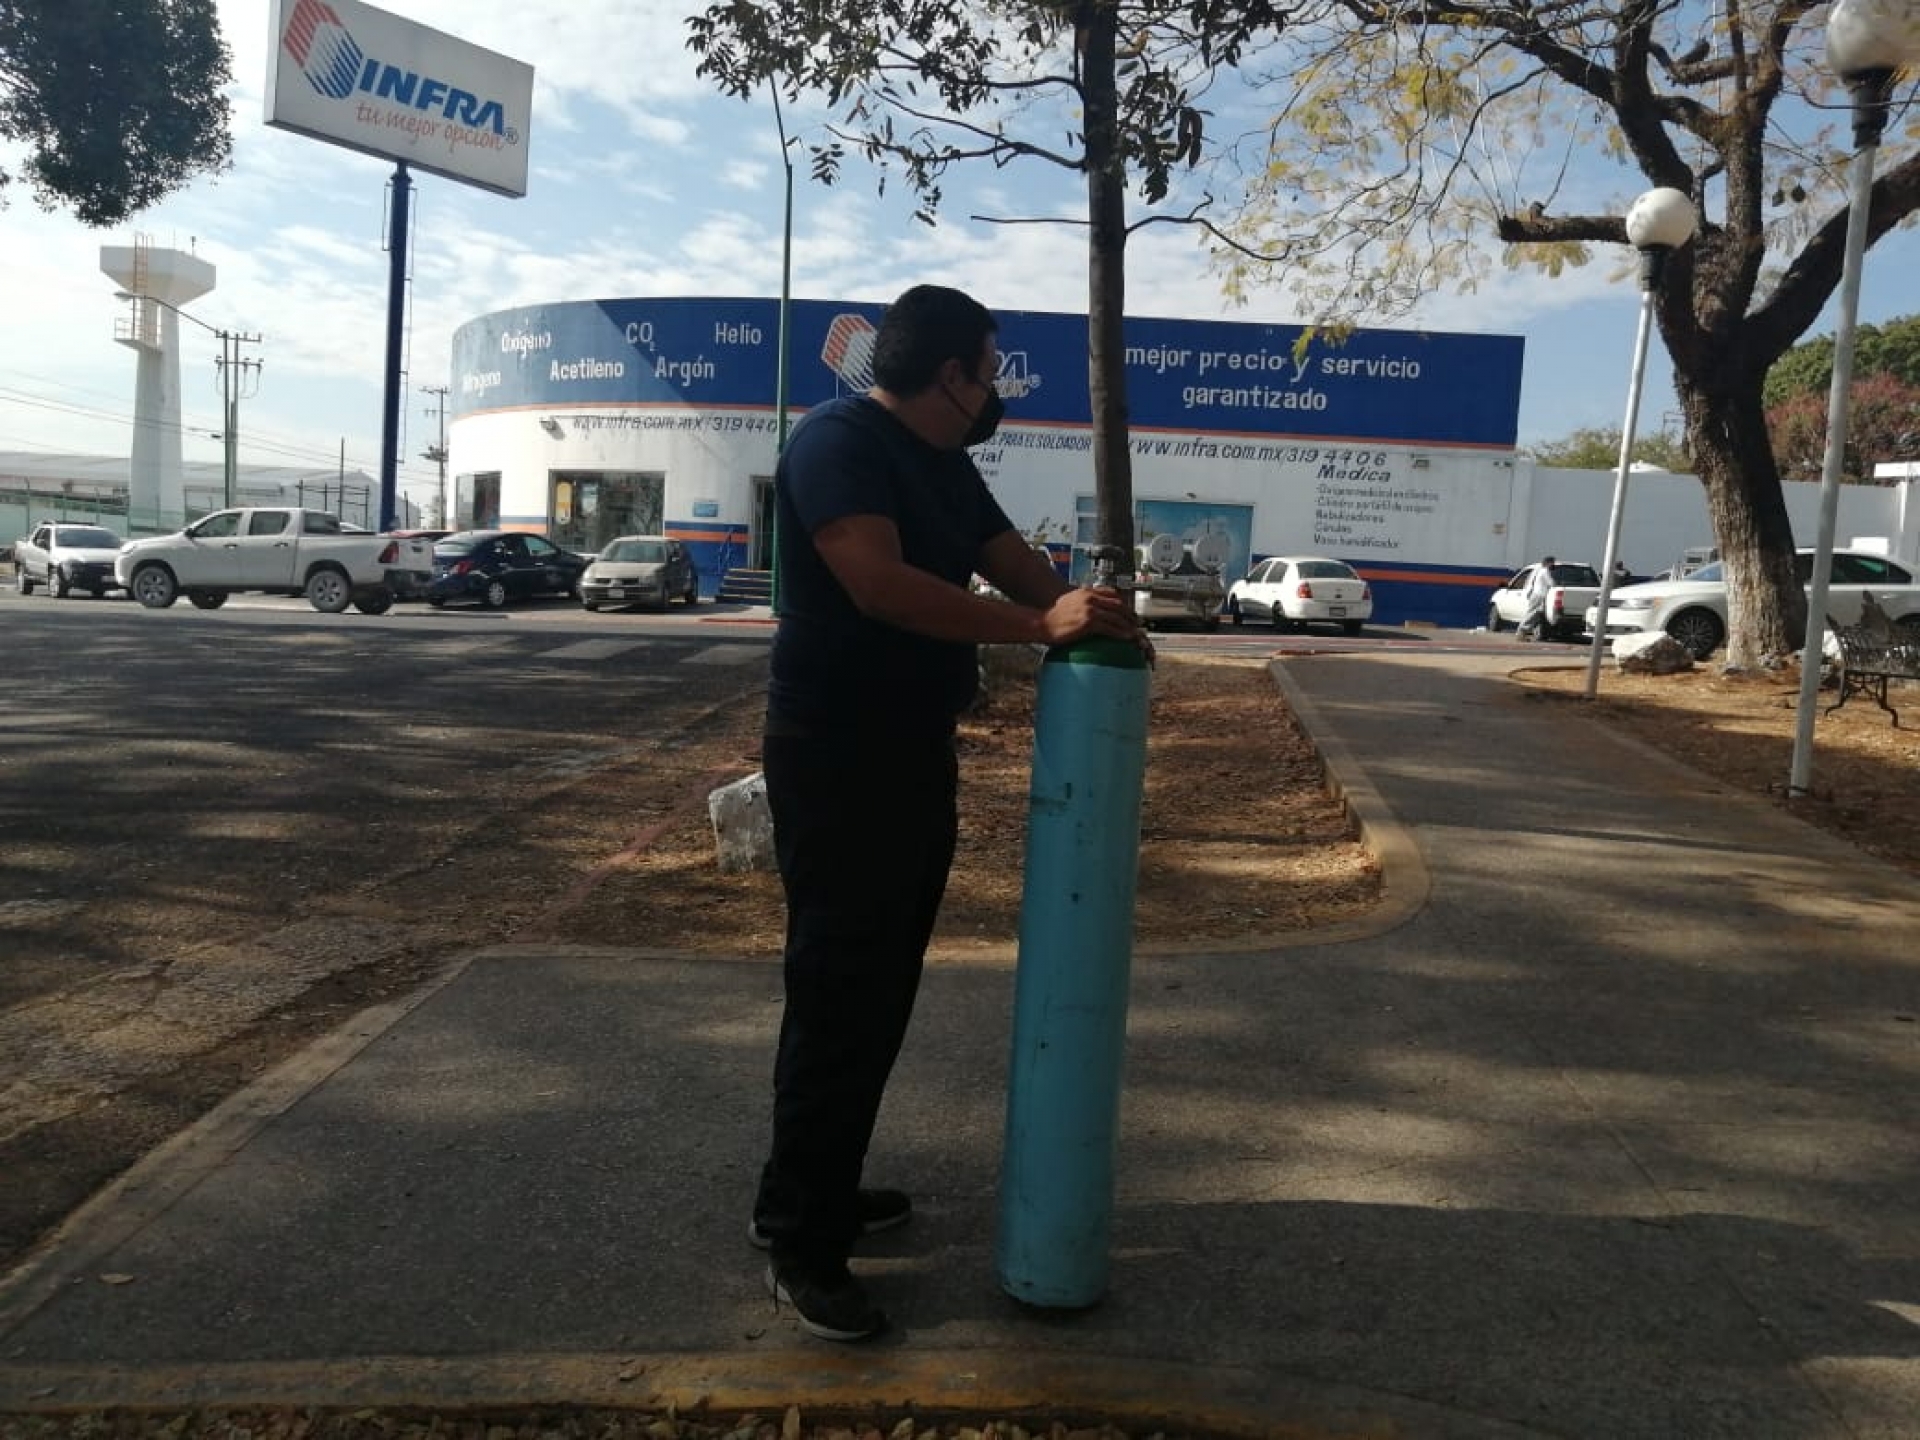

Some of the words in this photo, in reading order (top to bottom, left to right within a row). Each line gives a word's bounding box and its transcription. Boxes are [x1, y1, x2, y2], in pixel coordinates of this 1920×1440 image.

[359, 58, 505, 135] INFRA
[357, 102, 385, 125] tu
[387, 111, 441, 144] mejor
[714, 322, 762, 345] Helio
[549, 358, 625, 381] Acetileno
[654, 355, 715, 386] Argón
[1124, 344, 1192, 375] mejor
[1199, 349, 1284, 376] precio
[1290, 352, 1310, 382] y
[1321, 354, 1421, 380] servicio
[1182, 384, 1327, 411] garantizado
[970, 449, 1003, 463] rial
